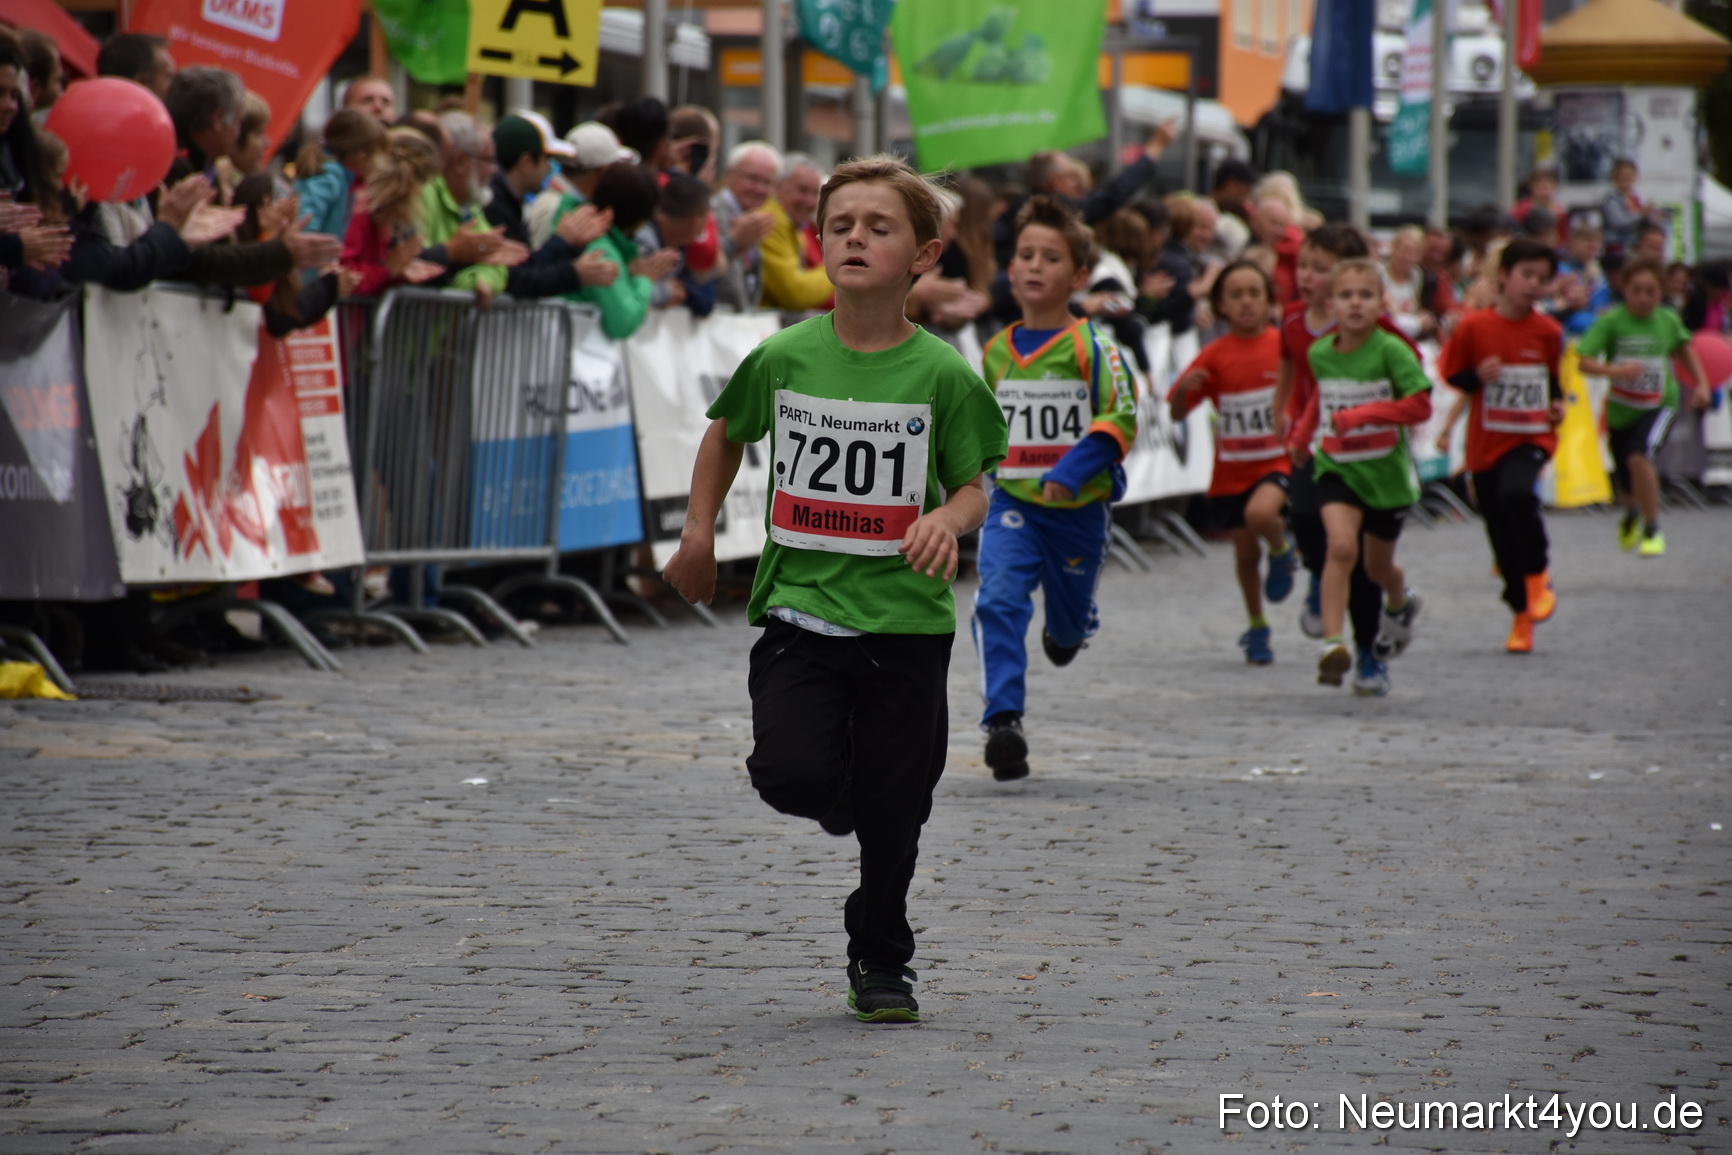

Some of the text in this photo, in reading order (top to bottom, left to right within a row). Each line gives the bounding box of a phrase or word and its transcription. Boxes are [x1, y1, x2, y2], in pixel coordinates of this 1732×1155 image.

[1023, 389, 1072, 400] Neumarkt
[779, 404, 901, 434] PARTL Neumarkt
[1001, 404, 1083, 441] 7104
[788, 429, 906, 497] 7201
[1019, 450, 1060, 465] Aaron
[792, 504, 885, 535] Matthias
